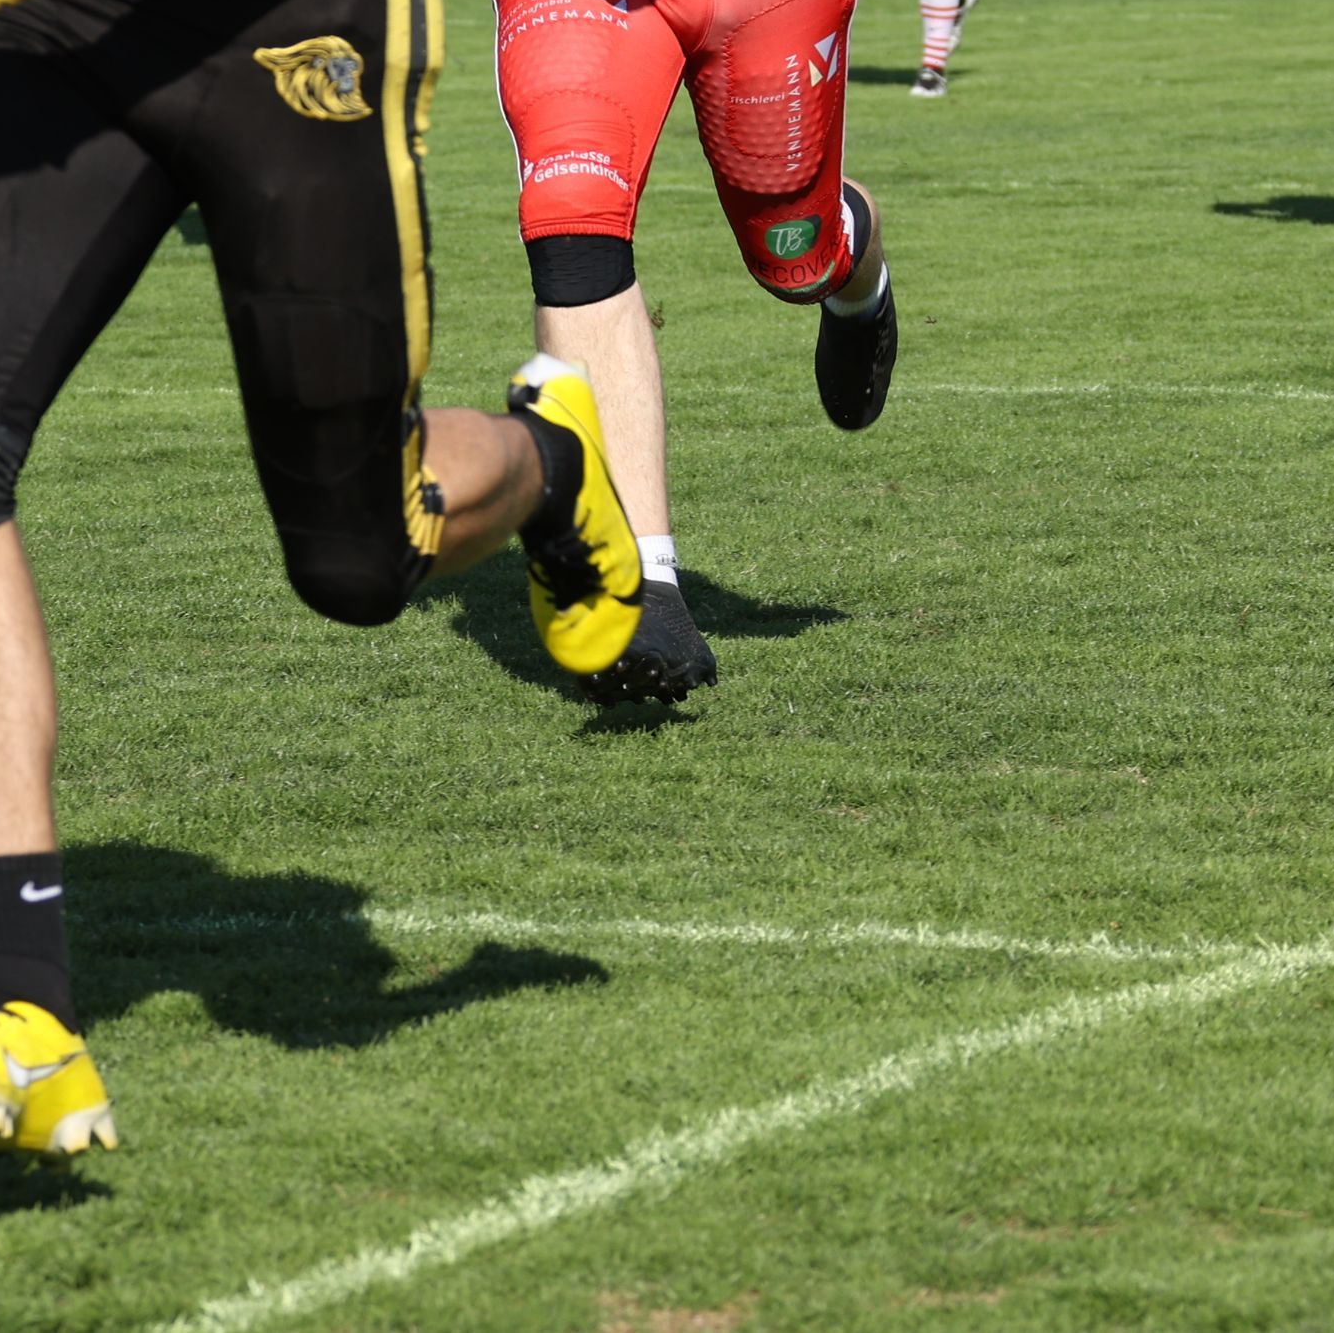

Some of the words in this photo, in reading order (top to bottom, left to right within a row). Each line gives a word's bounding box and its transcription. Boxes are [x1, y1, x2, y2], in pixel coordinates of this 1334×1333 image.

[501, 9, 630, 52] VENNEMANN
[785, 53, 802, 172] VENNEMANN
[534, 162, 630, 192] Gelsenkirchen
